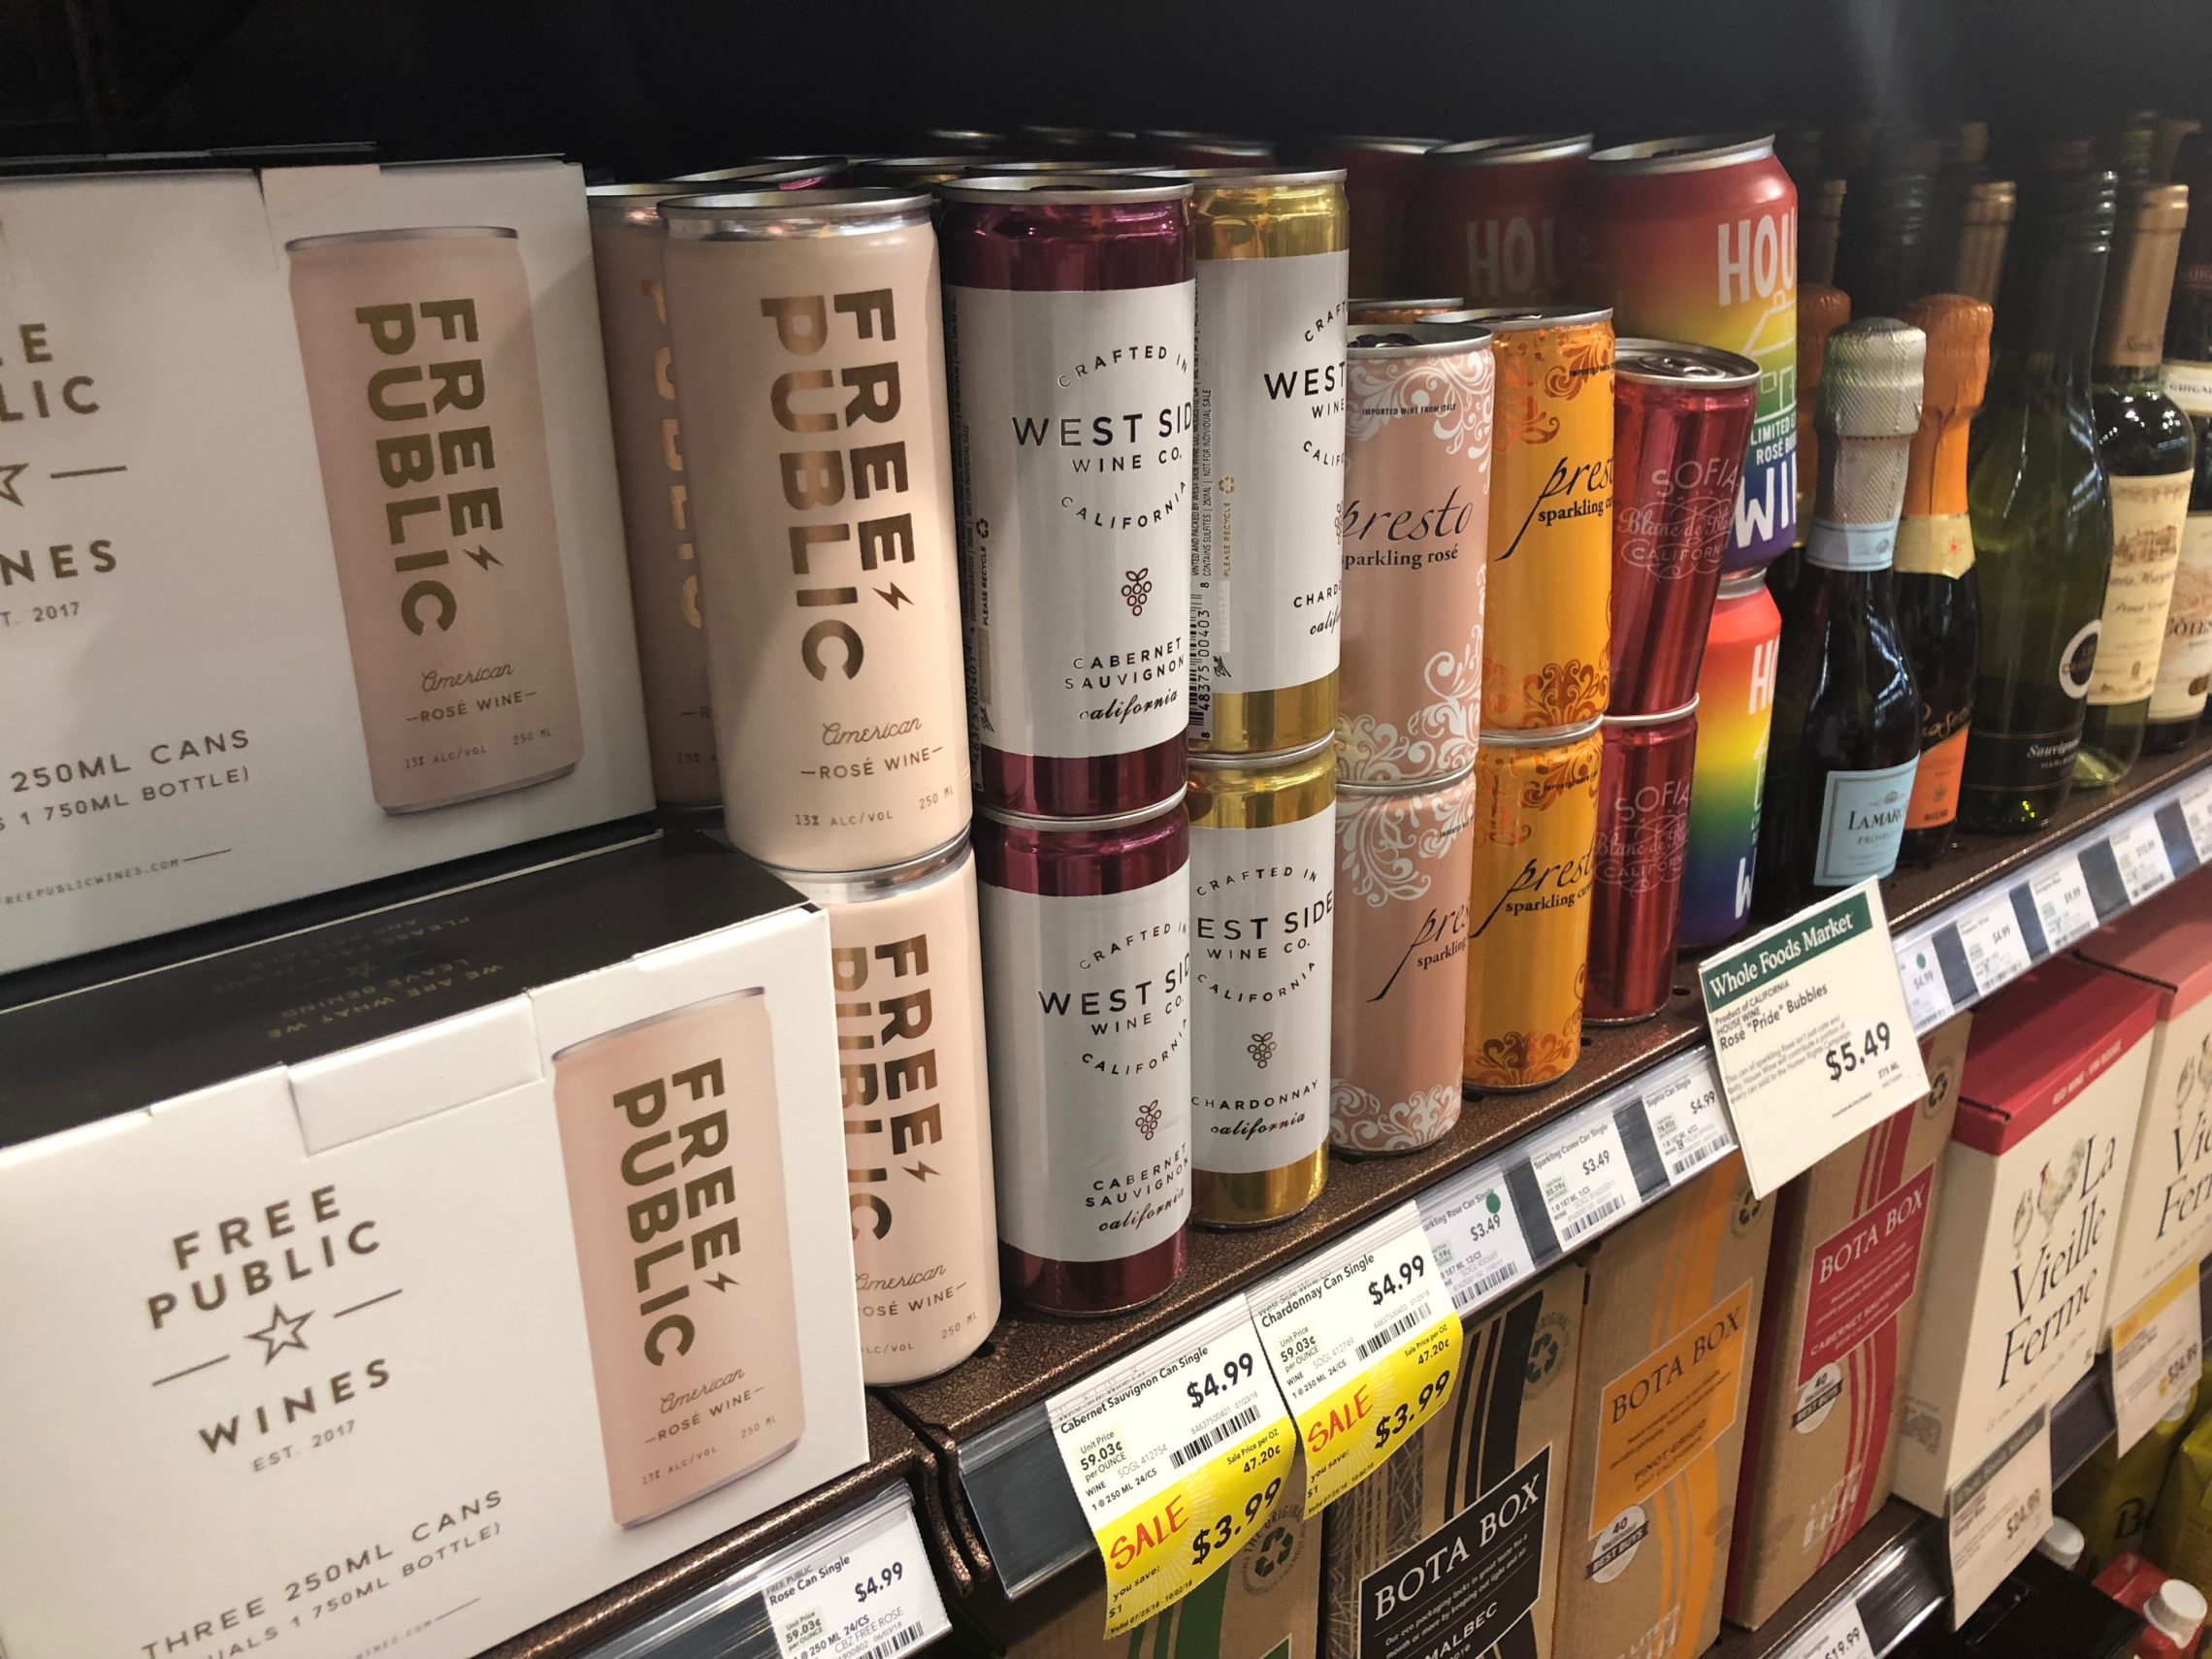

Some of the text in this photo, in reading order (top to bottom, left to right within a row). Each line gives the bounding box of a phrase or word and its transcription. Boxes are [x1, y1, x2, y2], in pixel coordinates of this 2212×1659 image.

[1057, 344, 1188, 388] CRAFTED IN
[1263, 361, 1346, 400] WEST
[419, 297, 504, 537] FREE
[833, 287, 915, 570] FREE
[1012, 401, 1193, 447] WEST SID
[1312, 398, 1345, 418] WINE
[355, 301, 458, 636] PUBLIC
[1072, 446, 1183, 473] WINE CO.
[1650, 457, 1740, 499] SOFIA
[761, 294, 864, 681] PUBLIC
[1060, 481, 1187, 531] CALIFORNIA
[1538, 498, 1604, 528] sparkling
[1427, 542, 1458, 563] rosé
[32, 601, 81, 623] 2017
[1064, 654, 1185, 691] SAUVIGNON
[1072, 635, 1182, 670] CABERNET
[421, 664, 515, 693] American
[1078, 685, 1179, 726] california
[822, 716, 923, 746] American
[11, 729, 249, 794] 250ML CANS
[44, 764, 250, 822] 750ML BOTTLE)
[919, 792, 939, 810] 250
[1614, 779, 1692, 823] SOFIA
[830, 809, 894, 827] ALC/VOL
[1195, 865, 1317, 896] CRAFTED IN
[1197, 889, 1334, 941] EST SIDE
[1506, 892, 1576, 917] sparkling
[1079, 922, 1171, 970] CRAFTED
[1207, 937, 1311, 961] WINE CO.
[1416, 936, 1467, 970] sparkling
[1708, 912, 1854, 999] Whole Foods Market
[1037, 980, 1153, 1017] WEST
[1196, 960, 1317, 1004] CALIFORNIA
[1786, 983, 1829, 1014] Bubbles
[874, 932, 943, 1155] FREE
[1090, 1012, 1153, 1036] WINE
[1081, 1017, 1188, 1076] CALIFORNIA
[1825, 1021, 1891, 1083] $5.49
[1190, 1079, 1319, 1111] CHARDONNAY
[1690, 1090, 1715, 1116] $4.99
[1210, 1110, 1307, 1141] california
[671, 1057, 741, 1271] FREE
[1091, 1141, 1187, 1192] CABERNET
[1582, 1150, 1610, 1177] $3.49
[2079, 1131, 2117, 1203] La
[173, 1184, 341, 1271] FREE
[612, 1077, 696, 1367] PUBLIC
[1470, 1213, 1501, 1242] $3.49
[1818, 1222, 1880, 1285] BOTA
[1884, 1183, 1926, 1238] BOX
[147, 1220, 380, 1330] PUBLIC
[2010, 1193, 2106, 1317] Vieille
[1260, 1252, 1376, 1328] Chardonnay Can Single
[1368, 1254, 1424, 1307] $4.99
[940, 1322, 961, 1340] 250
[1294, 1324, 1310, 1341] Price
[1997, 1266, 2098, 1390] Ferme
[1296, 1344, 1320, 1365] OUNCE
[1611, 1354, 1684, 1425] BOTA
[1692, 1305, 1740, 1366] BOX
[660, 1368, 746, 1415] American
[1060, 1345, 1209, 1435] Cabernet Sauvignon Can Single
[1186, 1351, 1253, 1410] $4.99
[1286, 1370, 1305, 1387] WINE
[198, 1357, 390, 1454] WINES
[1307, 1383, 1374, 1454] SALE
[1374, 1369, 1451, 1450] $3.99
[252, 1418, 356, 1473] EST. 2017
[1080, 1430, 1116, 1455] Unit Price
[1080, 1440, 1123, 1473] 59.03¢
[1097, 1451, 1127, 1475] OUNCE
[1226, 1444, 1258, 1466] Sale Price
[1243, 1444, 1282, 1475] 47.20¢
[1086, 1480, 1107, 1499] WINE
[1105, 1467, 1158, 1505] 250 ML 24/CS
[1109, 1493, 1190, 1571] SALE
[1191, 1477, 1283, 1566] $3.99
[1611, 1515, 1629, 1535] 40
[1374, 1535, 1471, 1622] BOTA
[1480, 1472, 1541, 1549] BOX
[142, 1488, 503, 1659] THREE 250ML CANS
[311, 1521, 502, 1619] 750ML BOTTLE)
[768, 1554, 851, 1607] Rose Can Single
[855, 1560, 904, 1604] $4.99
[1113, 1582, 1132, 1603] you
[809, 1613, 870, 1656] 250 ML 24/CS
[878, 1606, 904, 1629] ROSE
[1424, 1601, 1498, 1659] MALBEC
